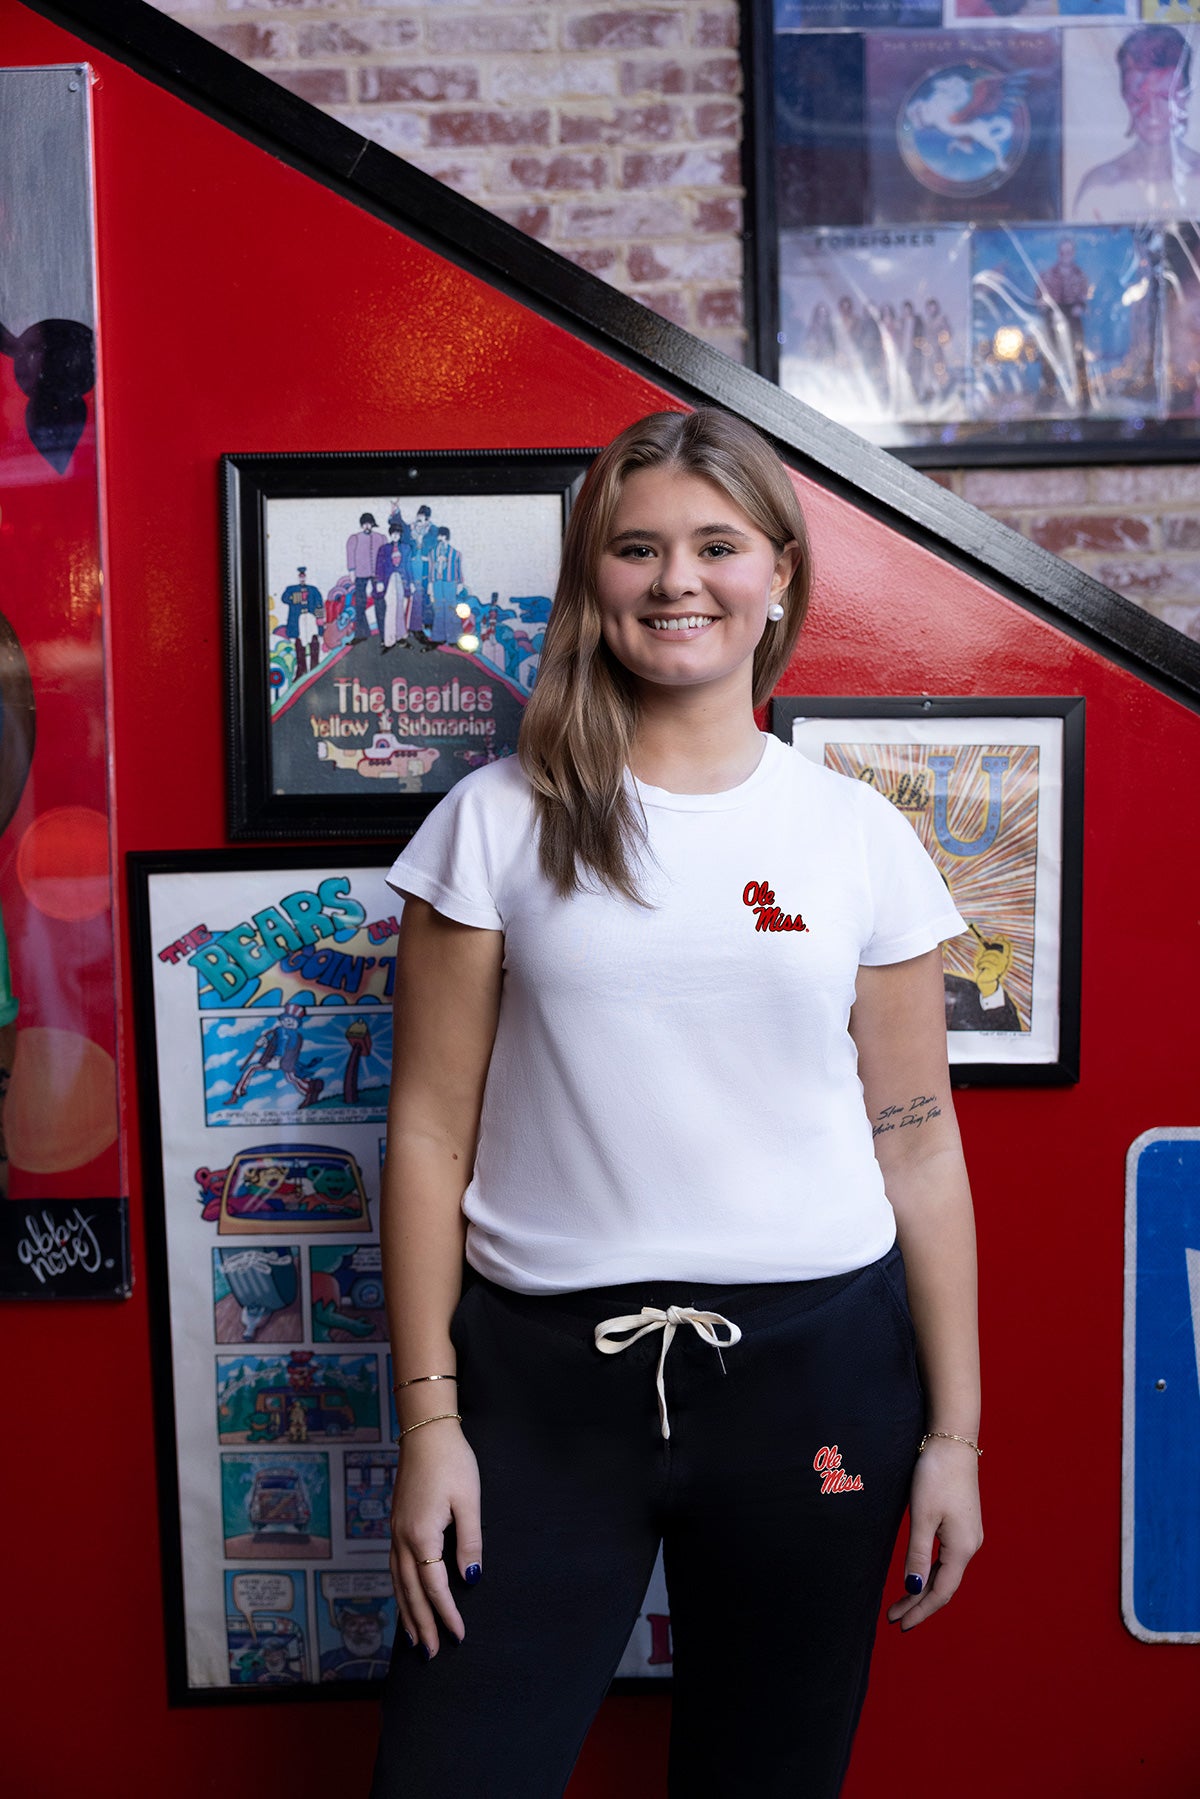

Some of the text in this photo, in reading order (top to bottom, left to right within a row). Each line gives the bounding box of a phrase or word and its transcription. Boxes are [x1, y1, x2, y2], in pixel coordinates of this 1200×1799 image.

[333, 677, 493, 714] The Beatles
[310, 713, 496, 738] Yellow Submarine
[927, 756, 1010, 856] U
[743, 881, 775, 906] Ole
[157, 876, 400, 1002] THE BEARS IN
[280, 944, 376, 994] GOIN'
[813, 1445, 842, 1471] Ole
